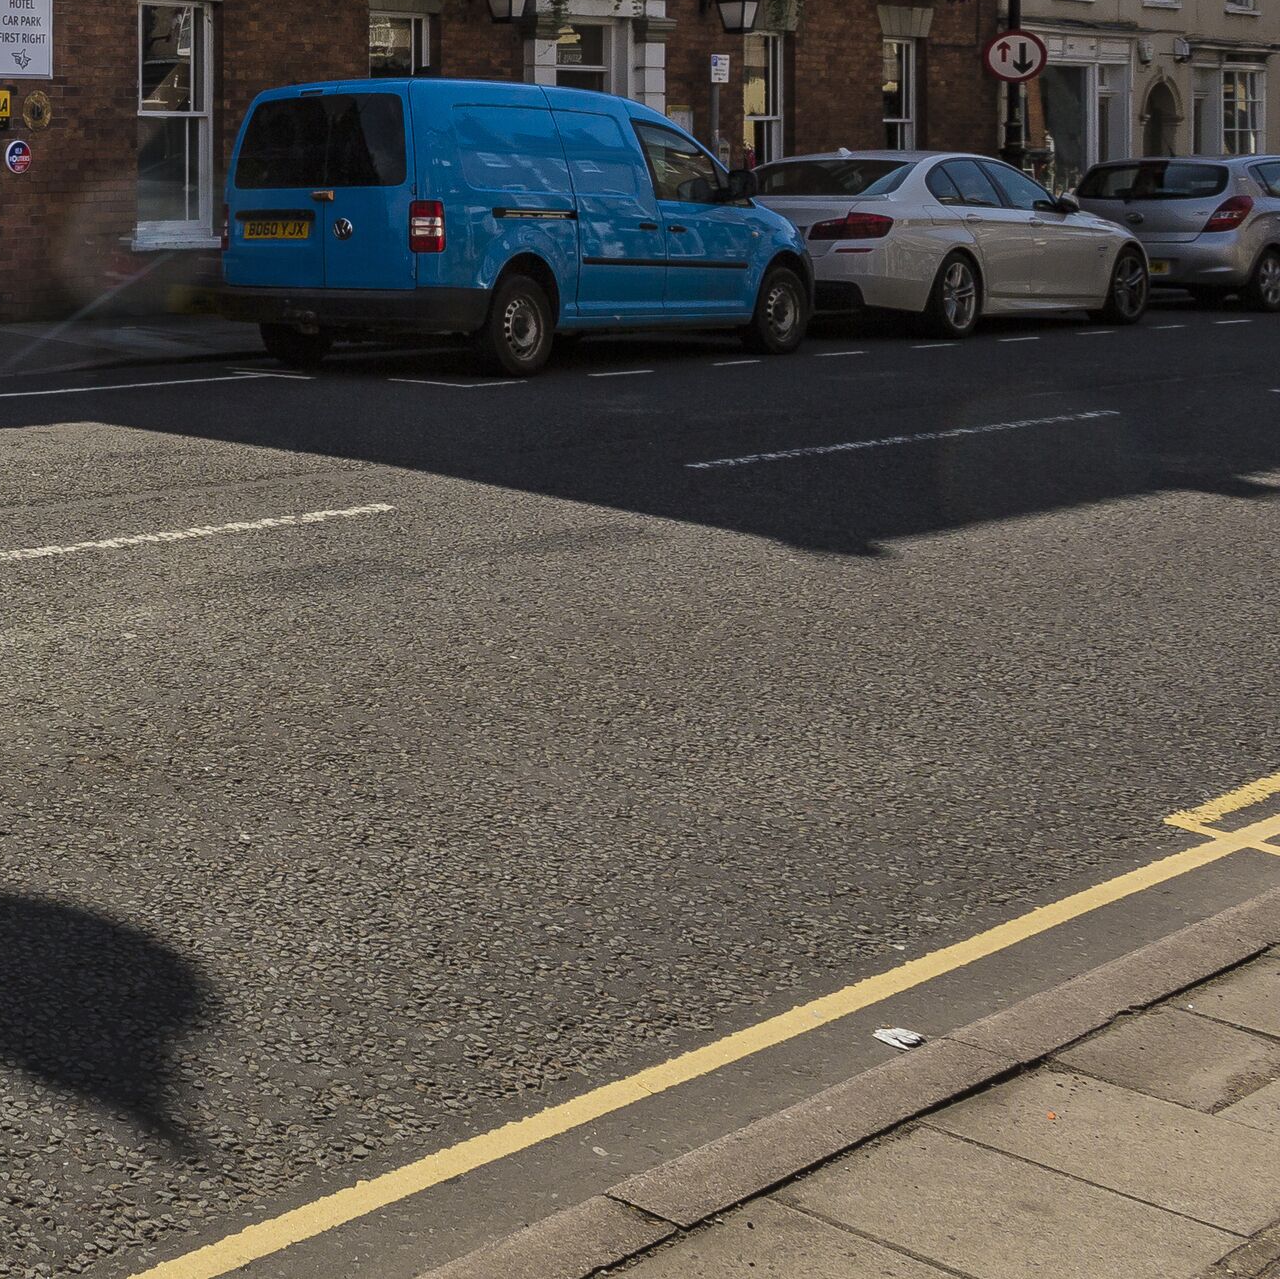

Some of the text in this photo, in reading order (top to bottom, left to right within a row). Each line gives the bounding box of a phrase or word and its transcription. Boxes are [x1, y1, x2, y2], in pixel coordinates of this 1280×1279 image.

[2, 15, 42, 27] CAR PARK
[21, 33, 46, 44] RIGHT
